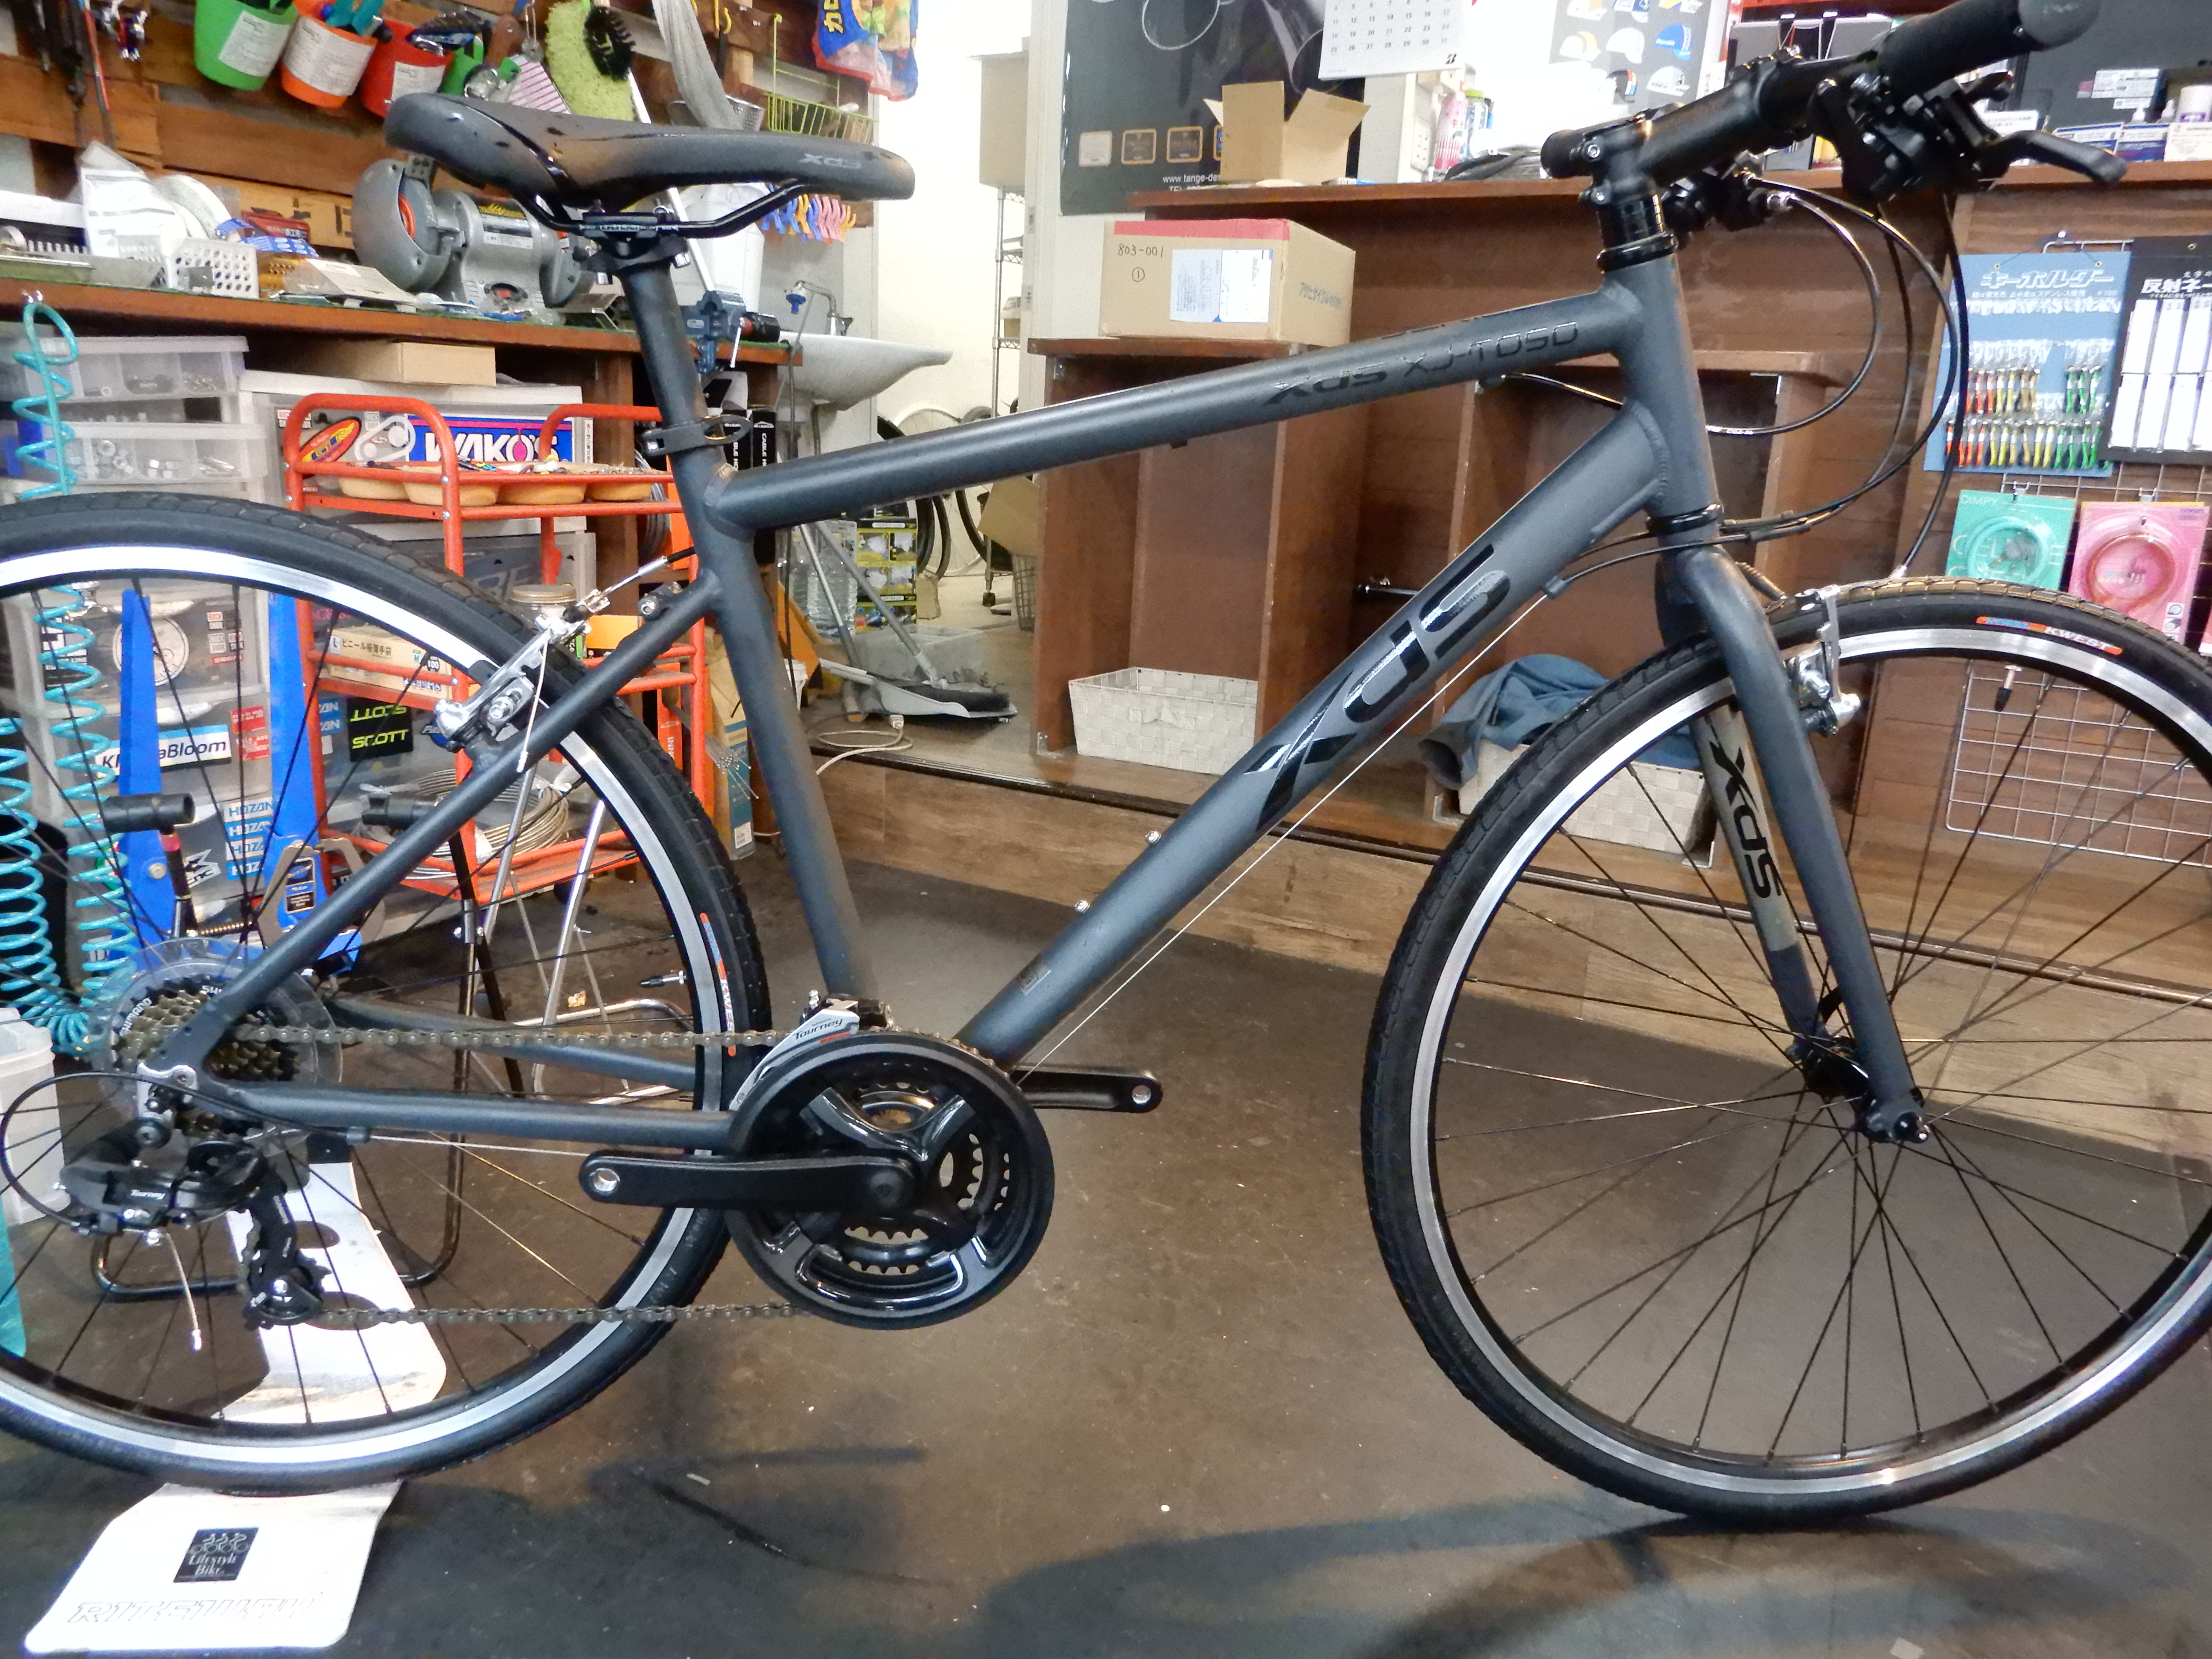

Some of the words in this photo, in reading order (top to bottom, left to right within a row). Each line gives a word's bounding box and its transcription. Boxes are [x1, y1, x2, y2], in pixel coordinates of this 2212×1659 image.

[1118, 243, 1164, 258] 803-001
[1980, 269, 2114, 289] キーホルダー
[2044, 626, 2112, 652] KWEST
[352, 729, 409, 749] SCOTT
[719, 978, 735, 1033] KWES
[792, 1019, 843, 1040] Tourney
[131, 1189, 166, 1199] Tourney
